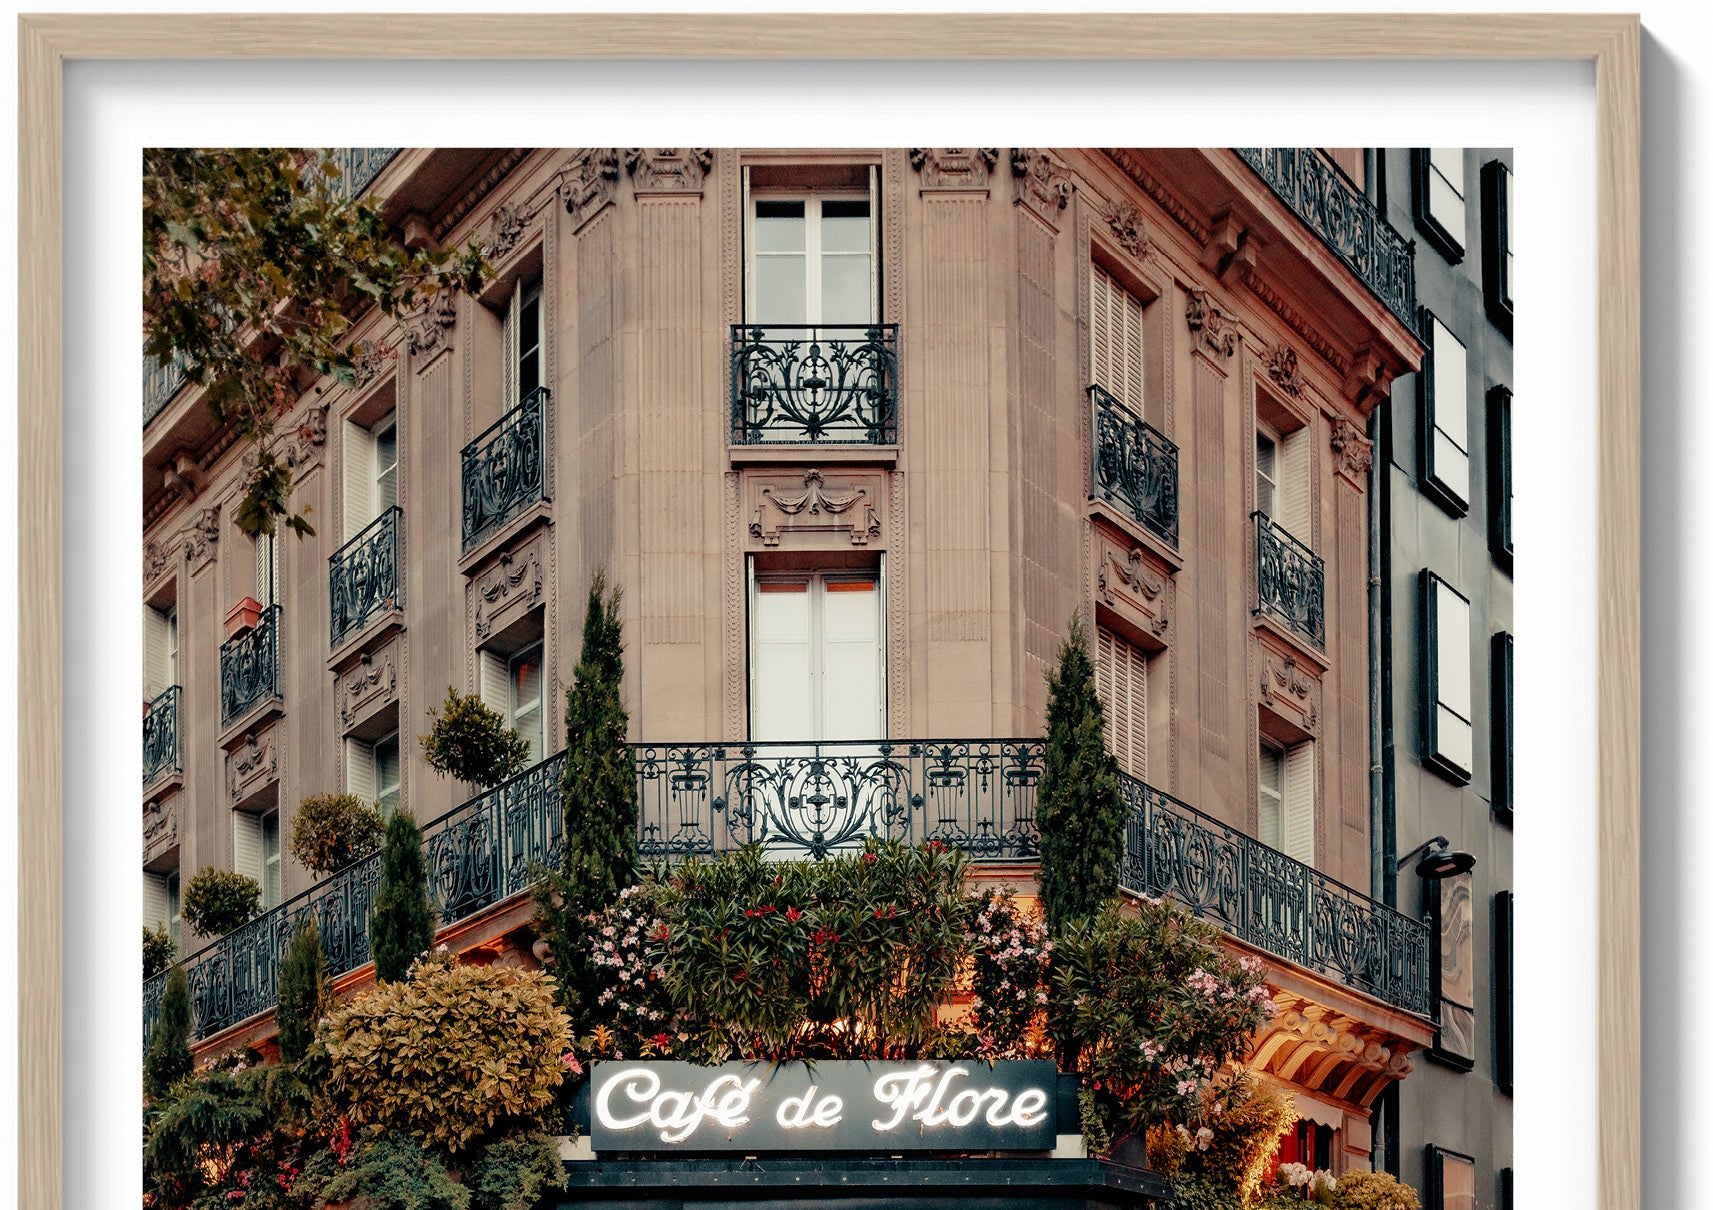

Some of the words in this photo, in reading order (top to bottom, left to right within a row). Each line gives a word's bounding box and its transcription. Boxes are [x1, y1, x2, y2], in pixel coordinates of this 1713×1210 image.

[595, 1067, 761, 1143] Café
[776, 1085, 843, 1129] de
[872, 1065, 1048, 1132] Flore
